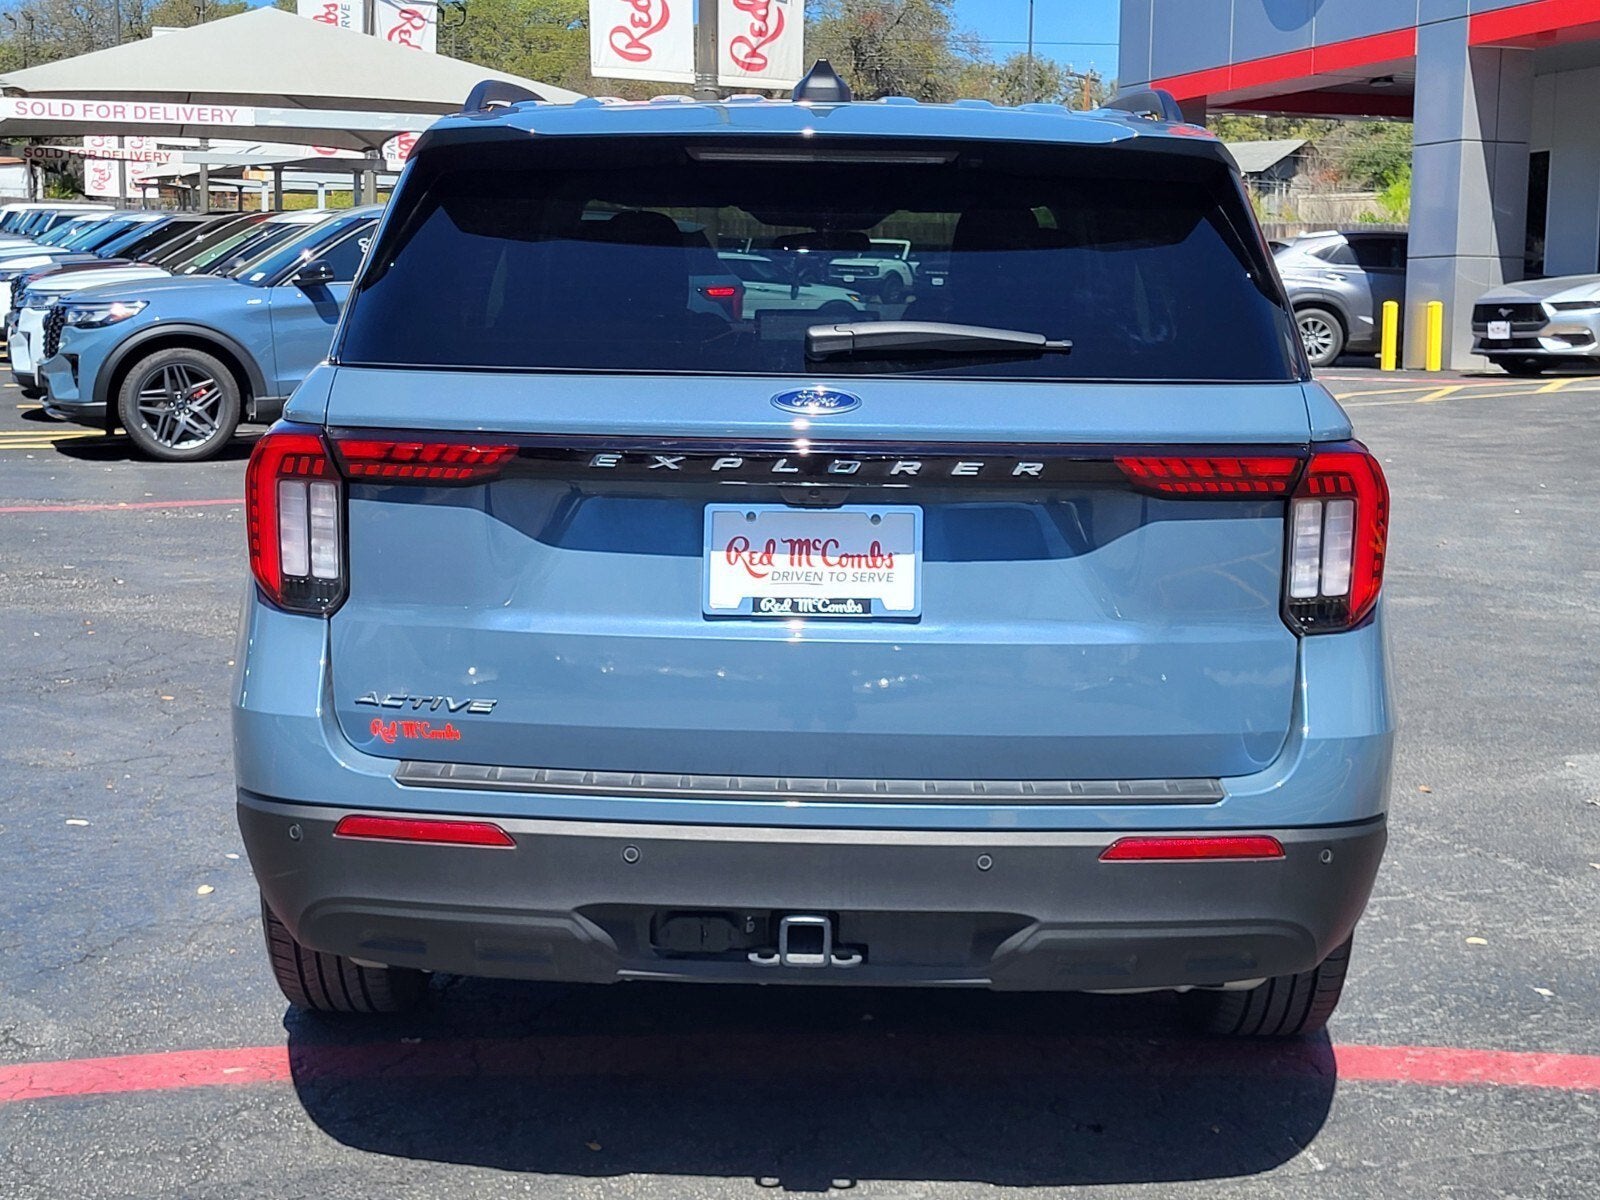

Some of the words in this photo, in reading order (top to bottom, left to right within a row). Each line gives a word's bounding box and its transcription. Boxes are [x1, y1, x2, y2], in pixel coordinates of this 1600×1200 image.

[341, 3, 351, 28] RVE
[15, 101, 75, 117] SOLD
[83, 104, 126, 119] FOR
[134, 105, 238, 123] DELIVERY
[24, 147, 64, 159] SOLD
[69, 149, 97, 160] FOR
[102, 150, 171, 163] DELIVERY
[791, 388, 841, 408] Ford
[589, 453, 1045, 479] EXPLORER
[726, 536, 776, 579] Red
[780, 537, 895, 570] McCombs
[770, 571, 824, 583] DRIVEN
[829, 572, 848, 583] TO
[851, 572, 895, 583] SERVE
[760, 597, 792, 613] Red
[793, 598, 863, 613] McCombs
[355, 691, 497, 714] ACTIVE
[370, 718, 397, 744] Red
[398, 720, 461, 741] McCombs
